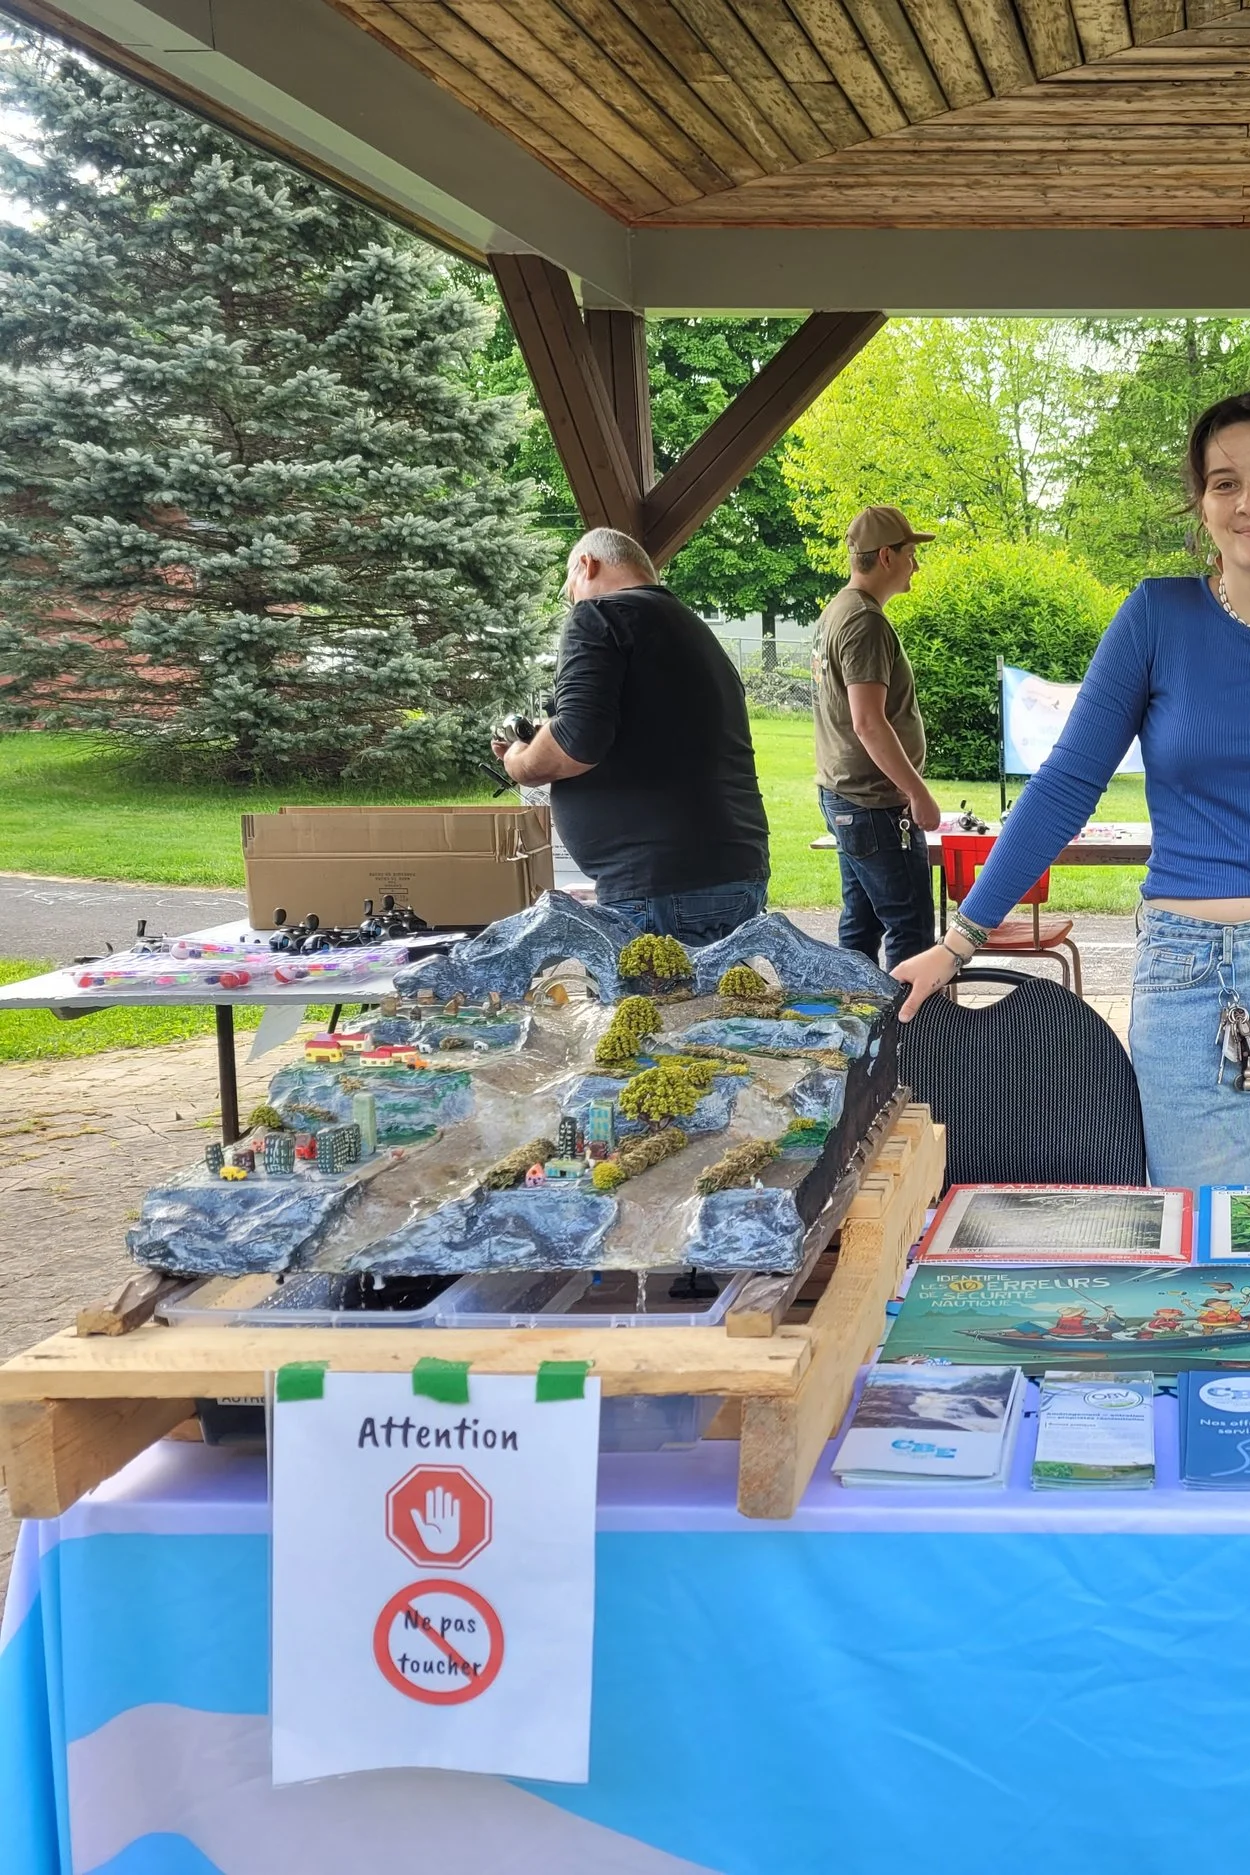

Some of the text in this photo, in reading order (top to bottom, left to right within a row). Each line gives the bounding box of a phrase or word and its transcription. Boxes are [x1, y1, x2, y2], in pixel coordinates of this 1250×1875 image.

[936, 1274, 1010, 1282] IDENTIFIE
[952, 1281, 978, 1291] 10
[986, 1277, 1110, 1292] ERREURS
[931, 1300, 1012, 1308] NAUTIQUE
[1091, 1391, 1130, 1400] OBV
[1200, 1418, 1226, 1427] Nos
[357, 1416, 519, 1451] Attention
[891, 1439, 958, 1459] CBE
[404, 1610, 477, 1638] Ne pas
[398, 1652, 482, 1677] toucher
